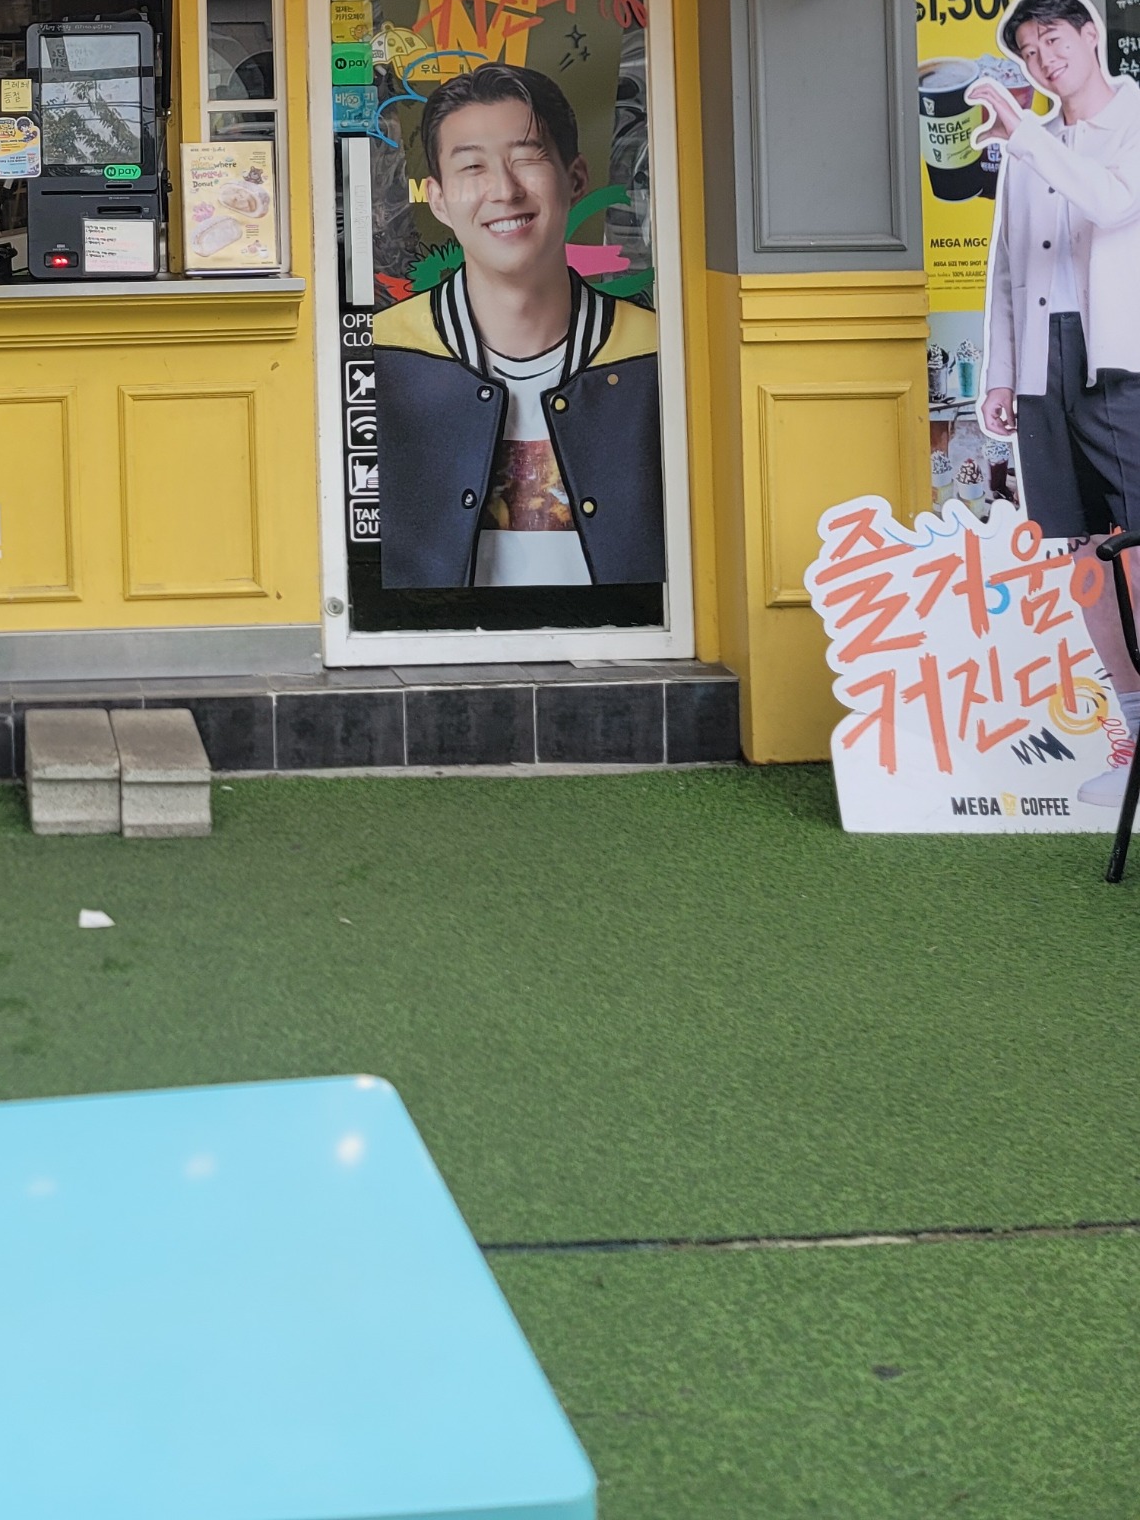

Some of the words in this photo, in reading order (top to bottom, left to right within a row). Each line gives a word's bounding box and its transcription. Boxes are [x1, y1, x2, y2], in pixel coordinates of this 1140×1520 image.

[927, 121, 963, 133] MEGA
[214, 161, 237, 169] where
[930, 238, 960, 248] MEGA
[963, 237, 987, 248] MGC
[343, 314, 374, 328] OPE
[354, 508, 381, 520] TAK
[841, 638, 1095, 776] 커진다
[951, 797, 1002, 816] MEGA
[1020, 797, 1071, 816] COFFEE
